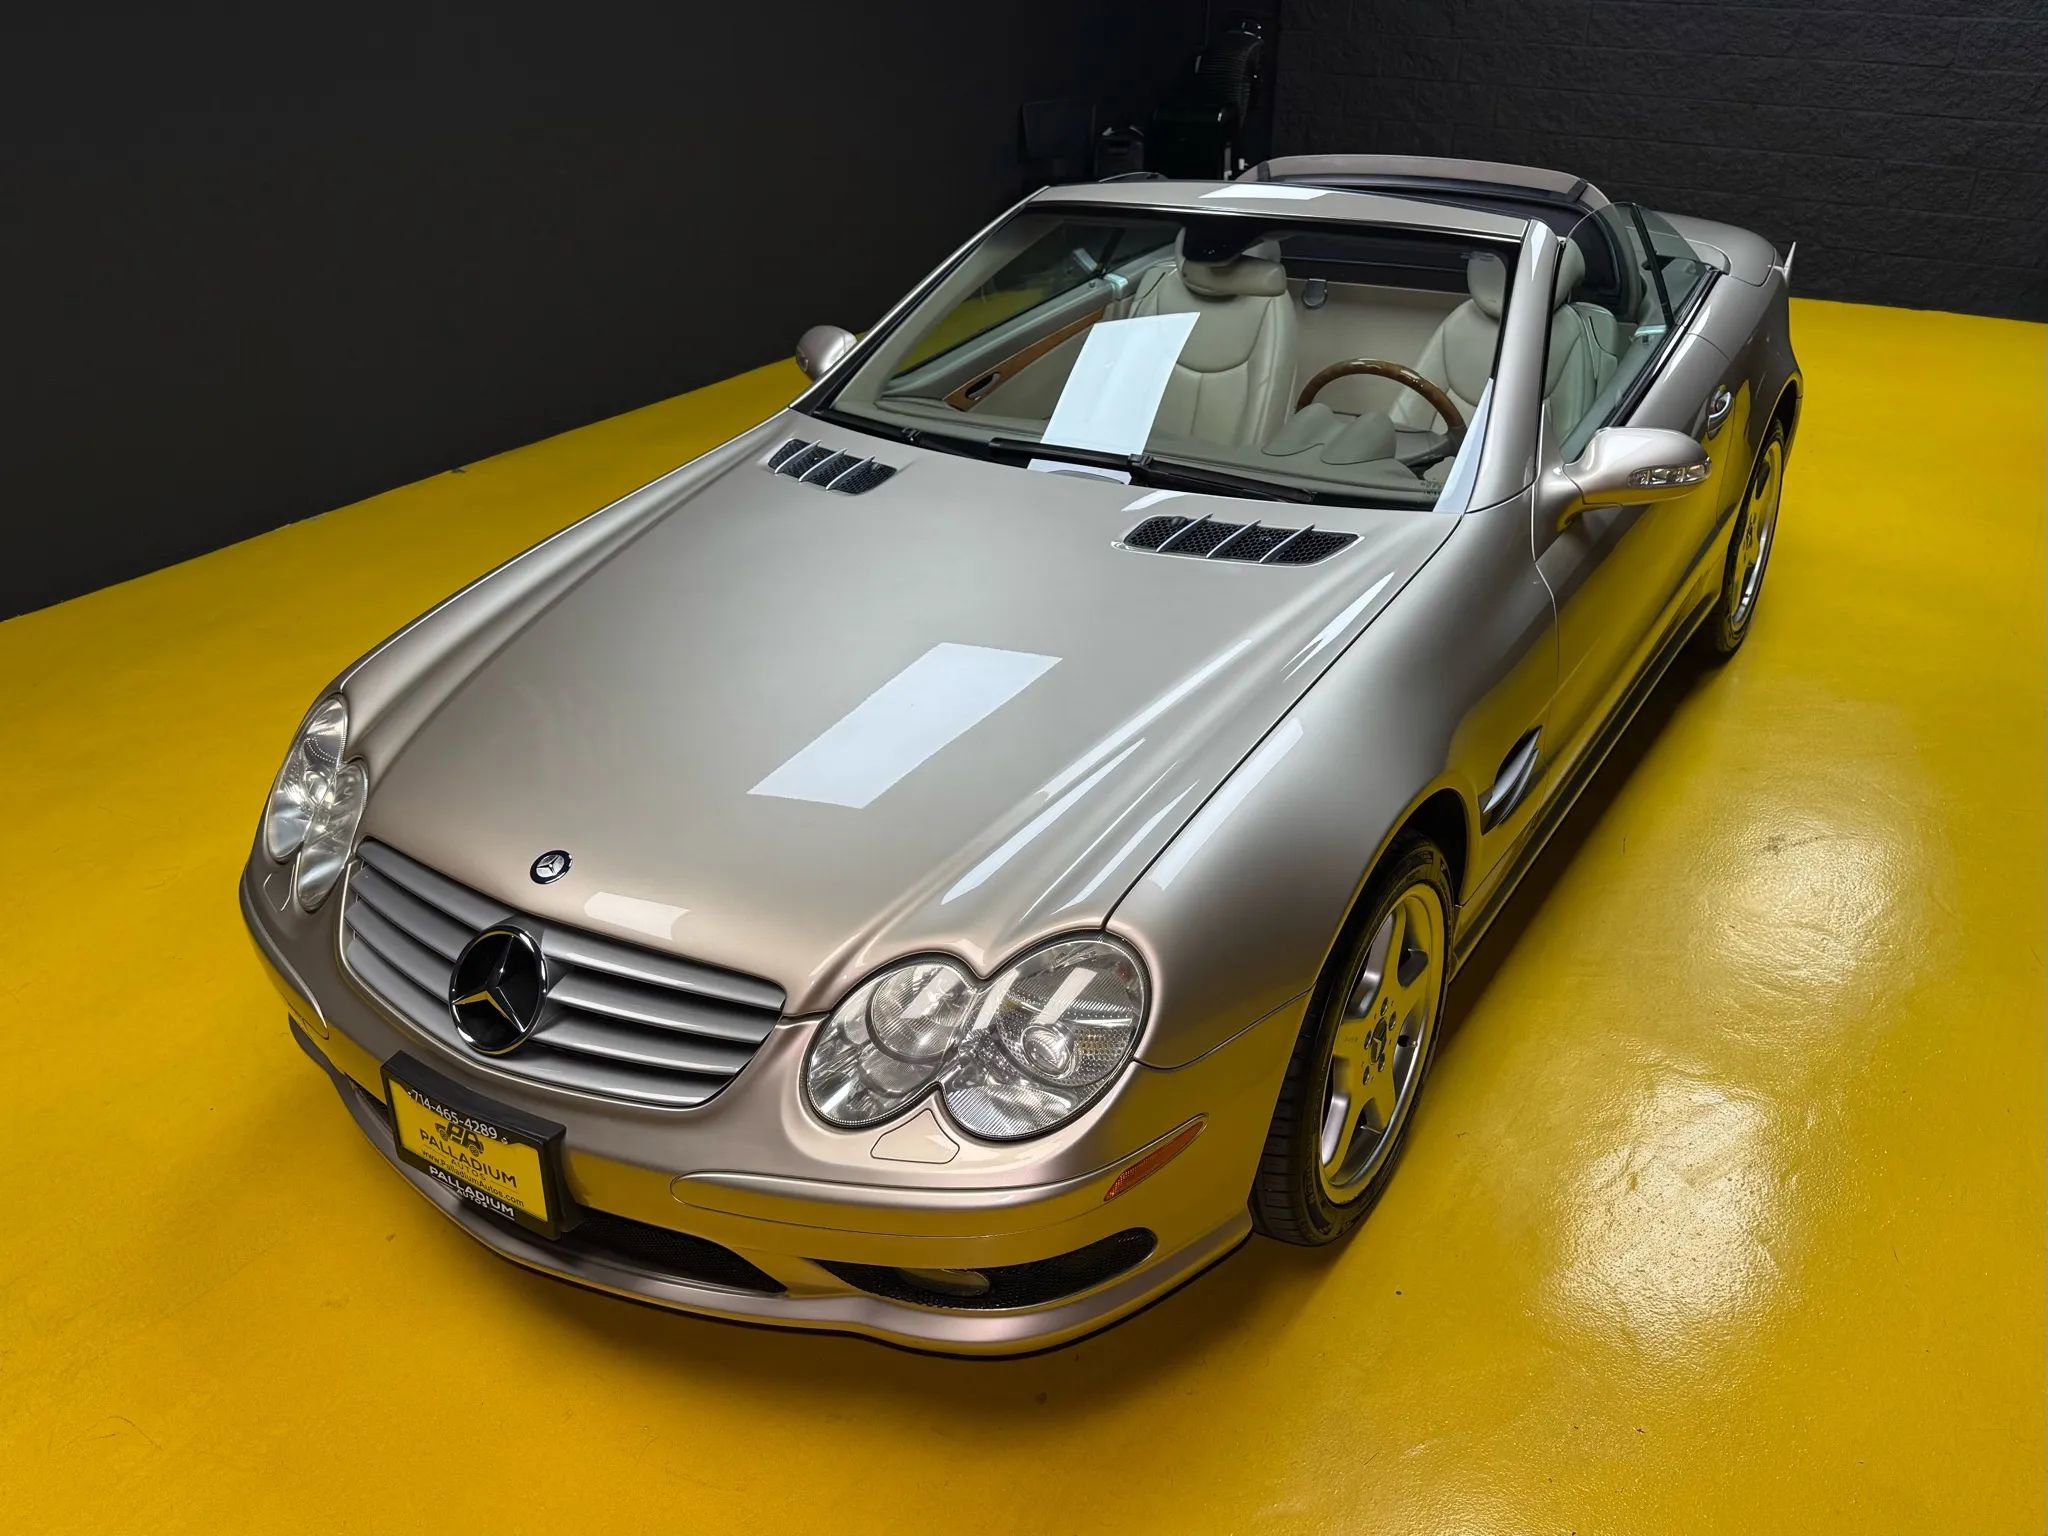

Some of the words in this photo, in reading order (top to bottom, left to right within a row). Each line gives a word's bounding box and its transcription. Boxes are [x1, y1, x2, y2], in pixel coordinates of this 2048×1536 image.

[412, 1090, 497, 1139] 714-465-4289
[420, 1129, 517, 1188] PALLADIUM
[422, 1151, 524, 1207] www.PalladiumAutos.com
[451, 1159, 486, 1181] AUTOS
[429, 1165, 513, 1216] PALLADIUM
[457, 1190, 488, 1208] AUTOS
